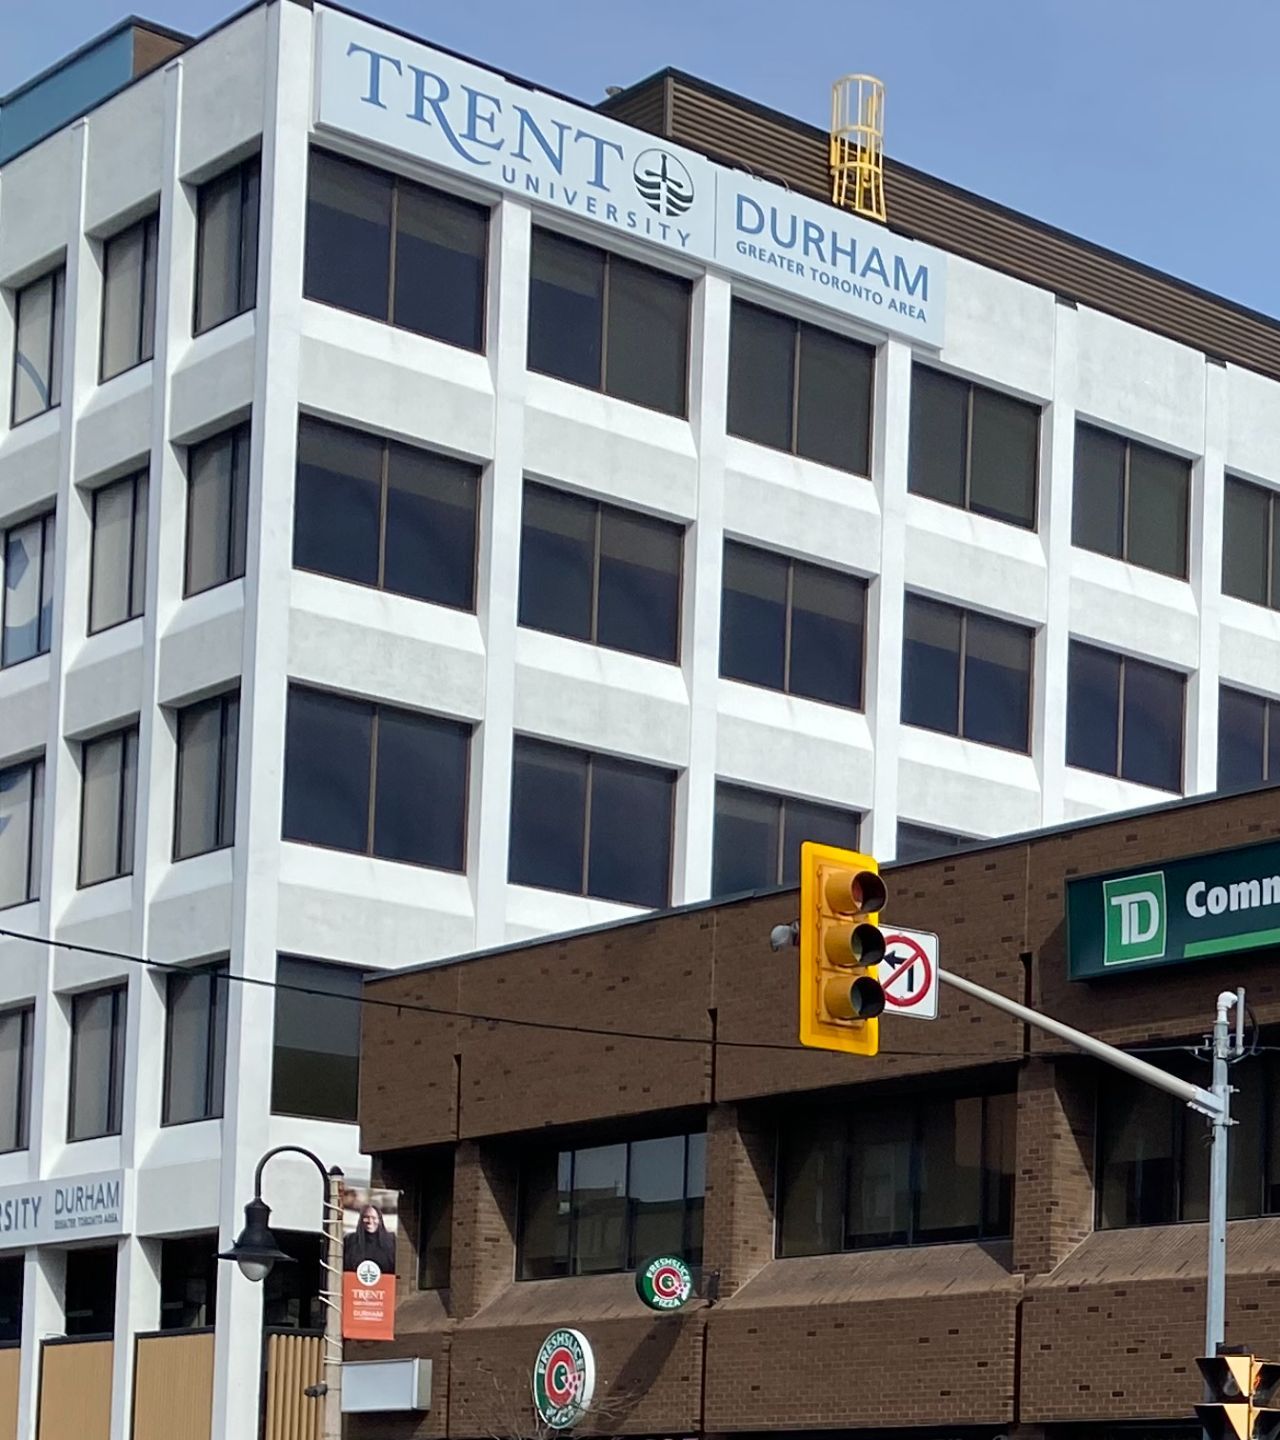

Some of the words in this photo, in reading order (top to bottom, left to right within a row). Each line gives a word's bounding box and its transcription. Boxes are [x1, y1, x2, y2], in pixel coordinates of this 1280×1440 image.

[346, 42, 624, 193] TRENT
[502, 166, 691, 248] UNIVERSITY
[736, 193, 929, 302] DURHAM
[736, 240, 805, 277] GREATER
[810, 267, 883, 305] TORONTO
[888, 298, 927, 323] AREA
[1110, 891, 1160, 946] TD
[0, 1195, 42, 1232] SITY
[55, 1181, 119, 1215] DURHAM
[351, 1288, 386, 1302] TRENT
[652, 1297, 682, 1308] PIZZA
[538, 1331, 585, 1374] FRESHSLICE
